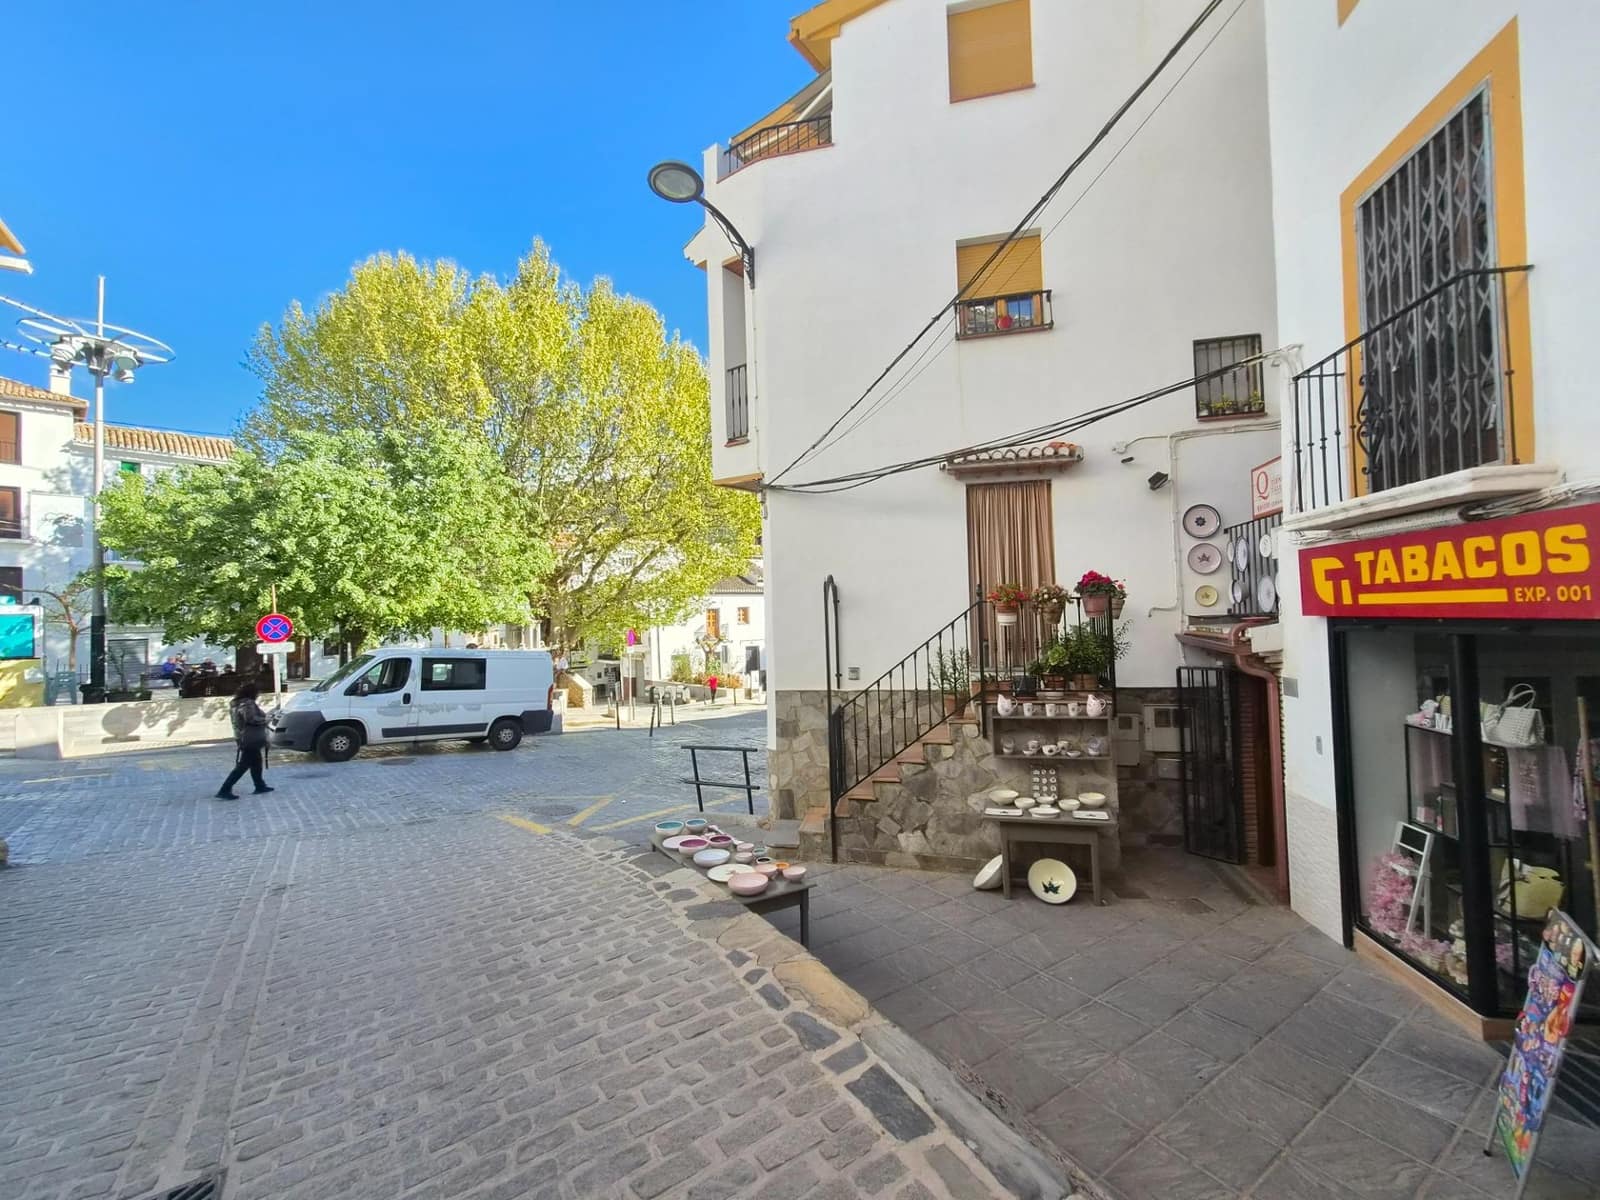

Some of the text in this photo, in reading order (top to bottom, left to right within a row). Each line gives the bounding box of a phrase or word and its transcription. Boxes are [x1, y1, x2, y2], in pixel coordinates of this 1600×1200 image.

[1354, 523, 1591, 585] TABACOS
[1514, 584, 1592, 603] EXP. 001
